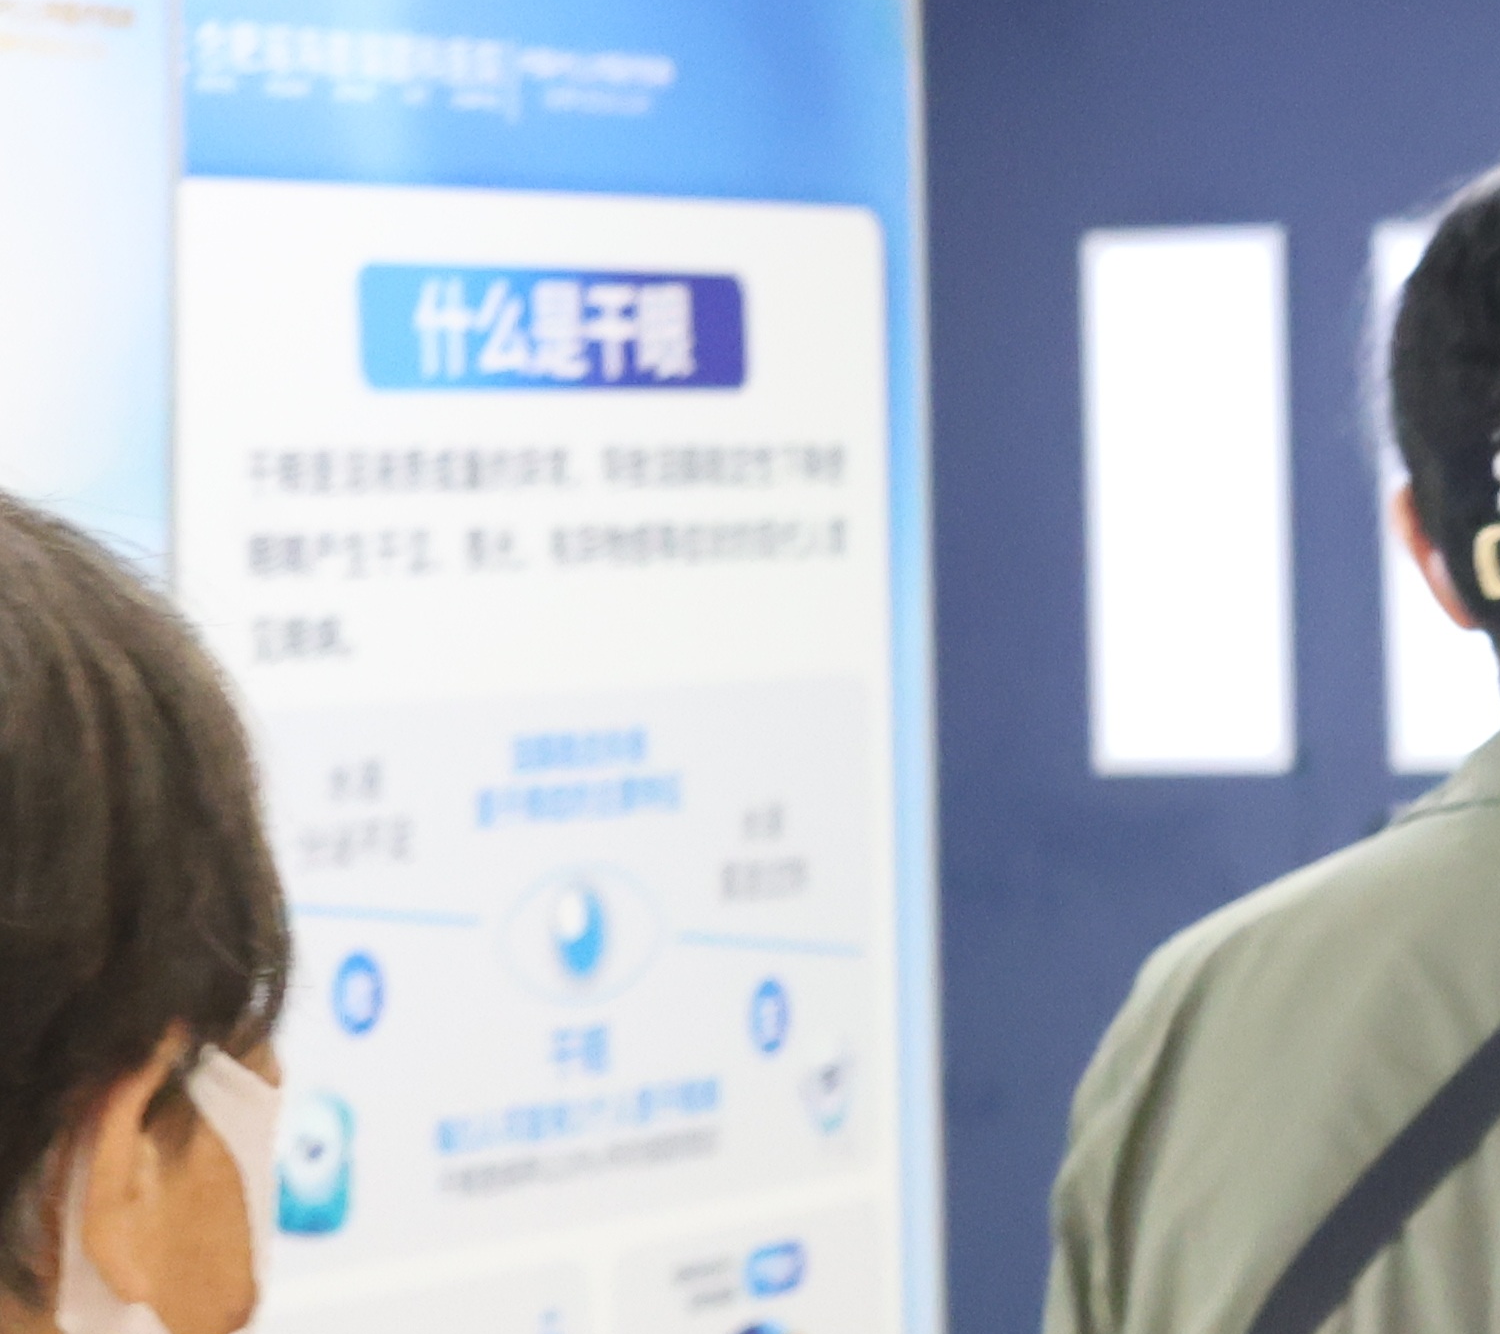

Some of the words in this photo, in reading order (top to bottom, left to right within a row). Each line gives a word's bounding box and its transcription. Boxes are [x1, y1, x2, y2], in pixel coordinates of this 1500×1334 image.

[413, 276, 698, 381] 什么是干眼
